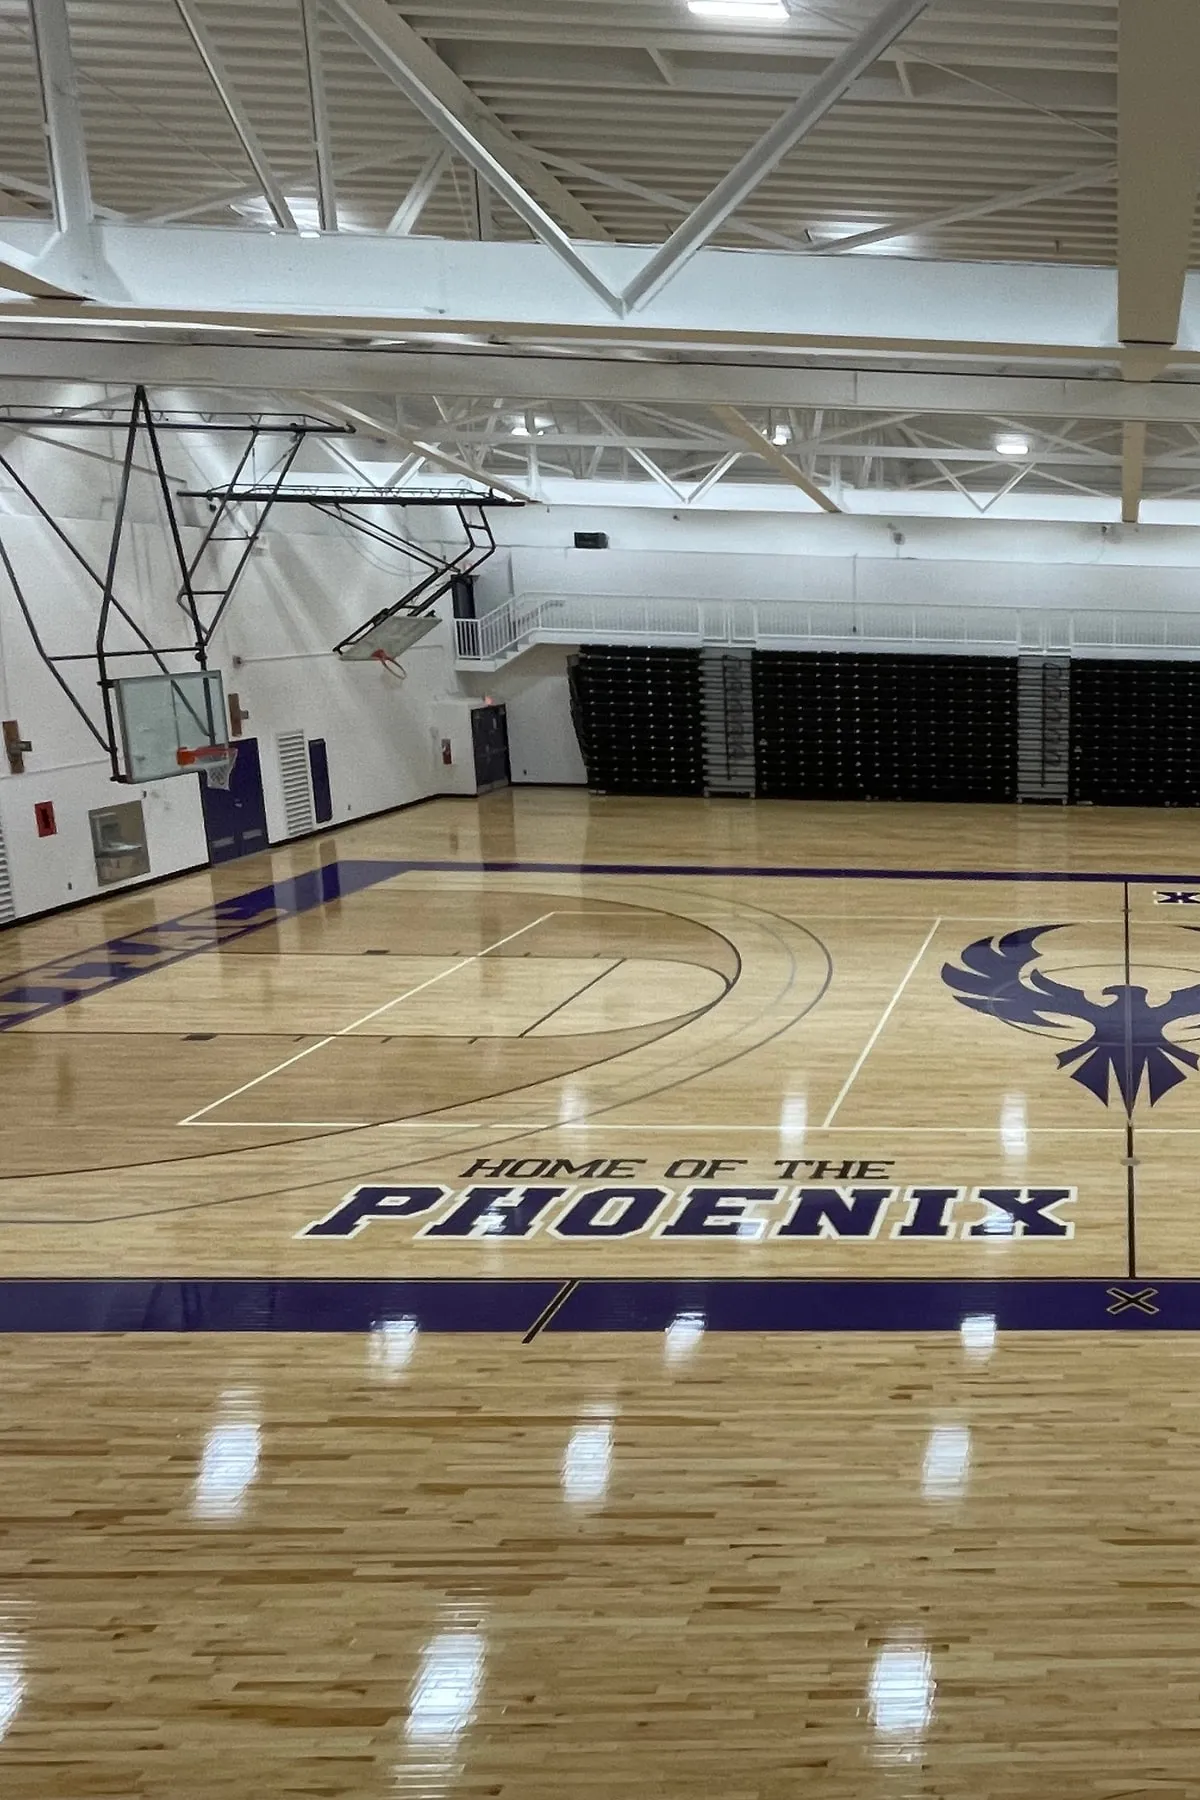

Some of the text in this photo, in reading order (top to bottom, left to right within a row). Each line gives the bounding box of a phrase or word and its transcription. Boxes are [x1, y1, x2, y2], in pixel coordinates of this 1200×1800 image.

[458, 1158, 895, 1180] HOME OF THE
[292, 1184, 1077, 1241] PHOENIX
